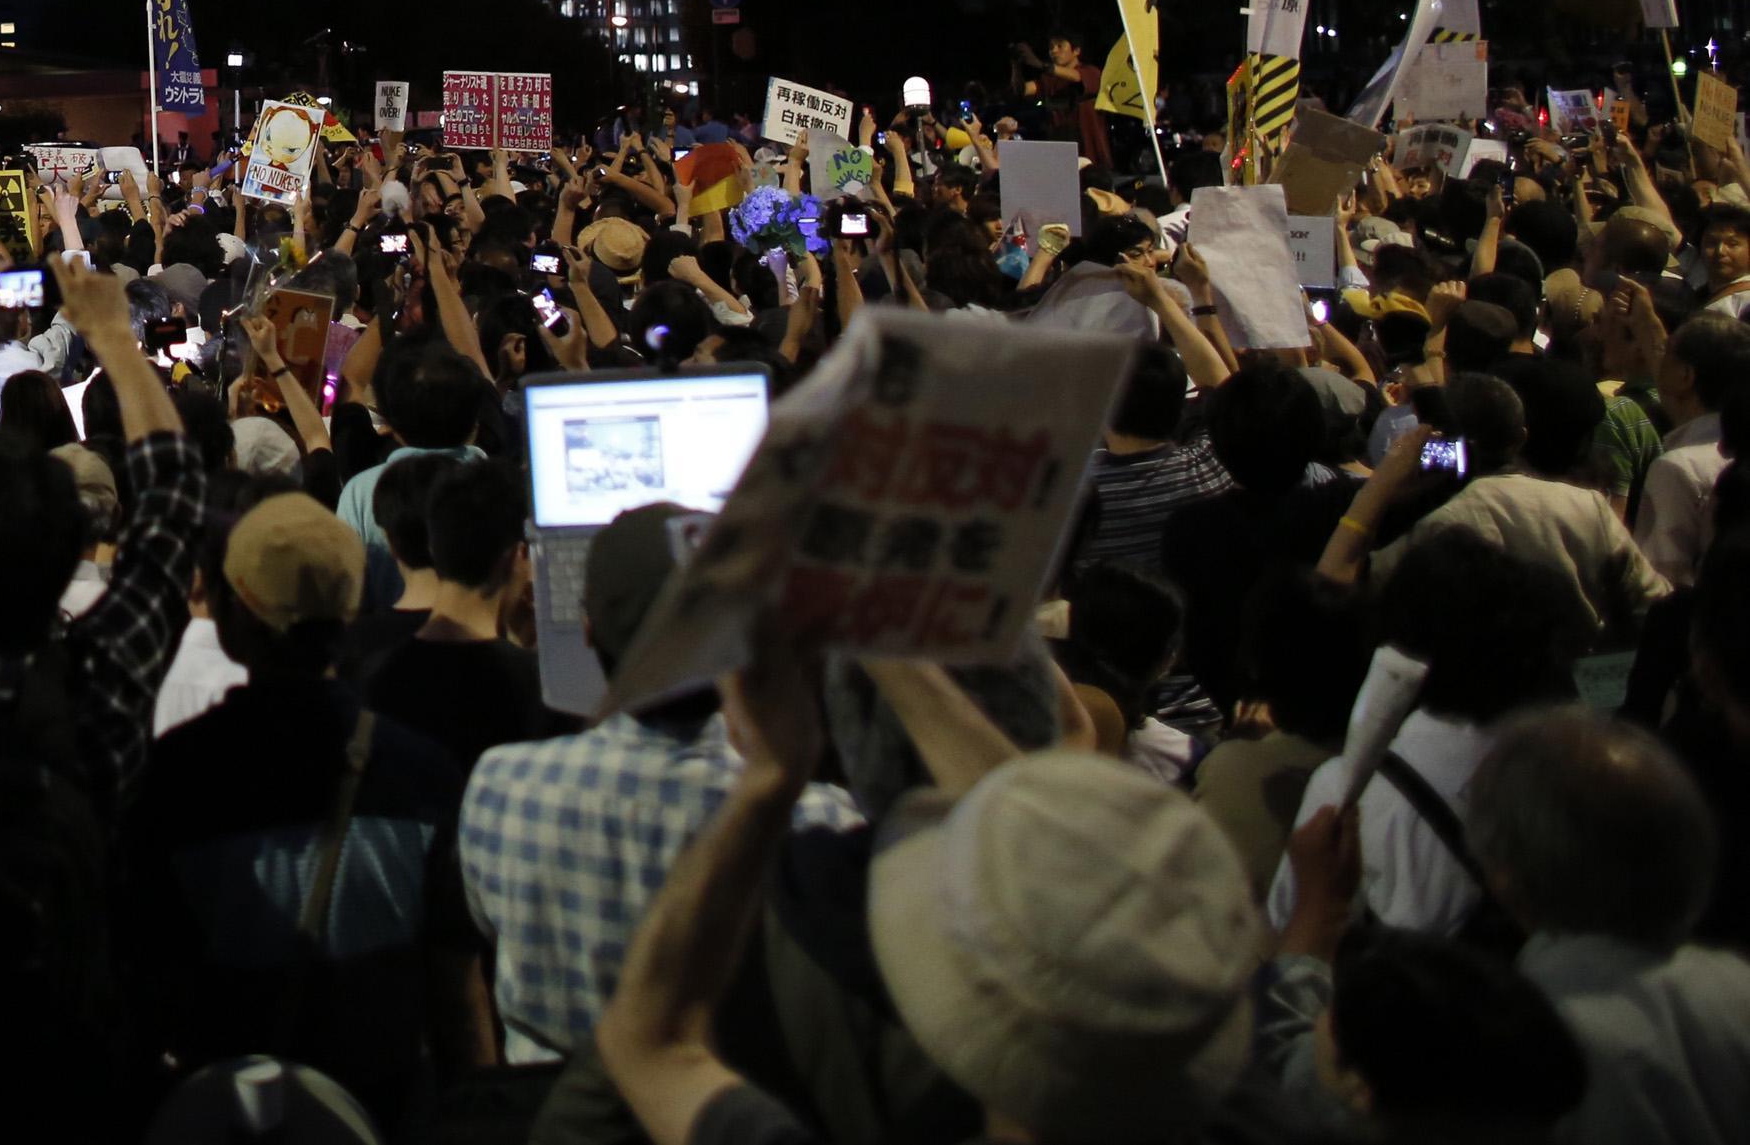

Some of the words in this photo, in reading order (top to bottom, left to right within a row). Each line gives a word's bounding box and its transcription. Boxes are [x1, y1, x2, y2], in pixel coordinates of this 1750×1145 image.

[381, 86, 401, 97] NUKE
[386, 96, 394, 107] IS
[777, 85, 848, 120] 再稼働反対
[379, 107, 401, 119] OVER!
[781, 109, 839, 134] 白紙撤回
[832, 149, 862, 171] NO
[252, 165, 266, 182] NO
[268, 169, 302, 193] NUKES
